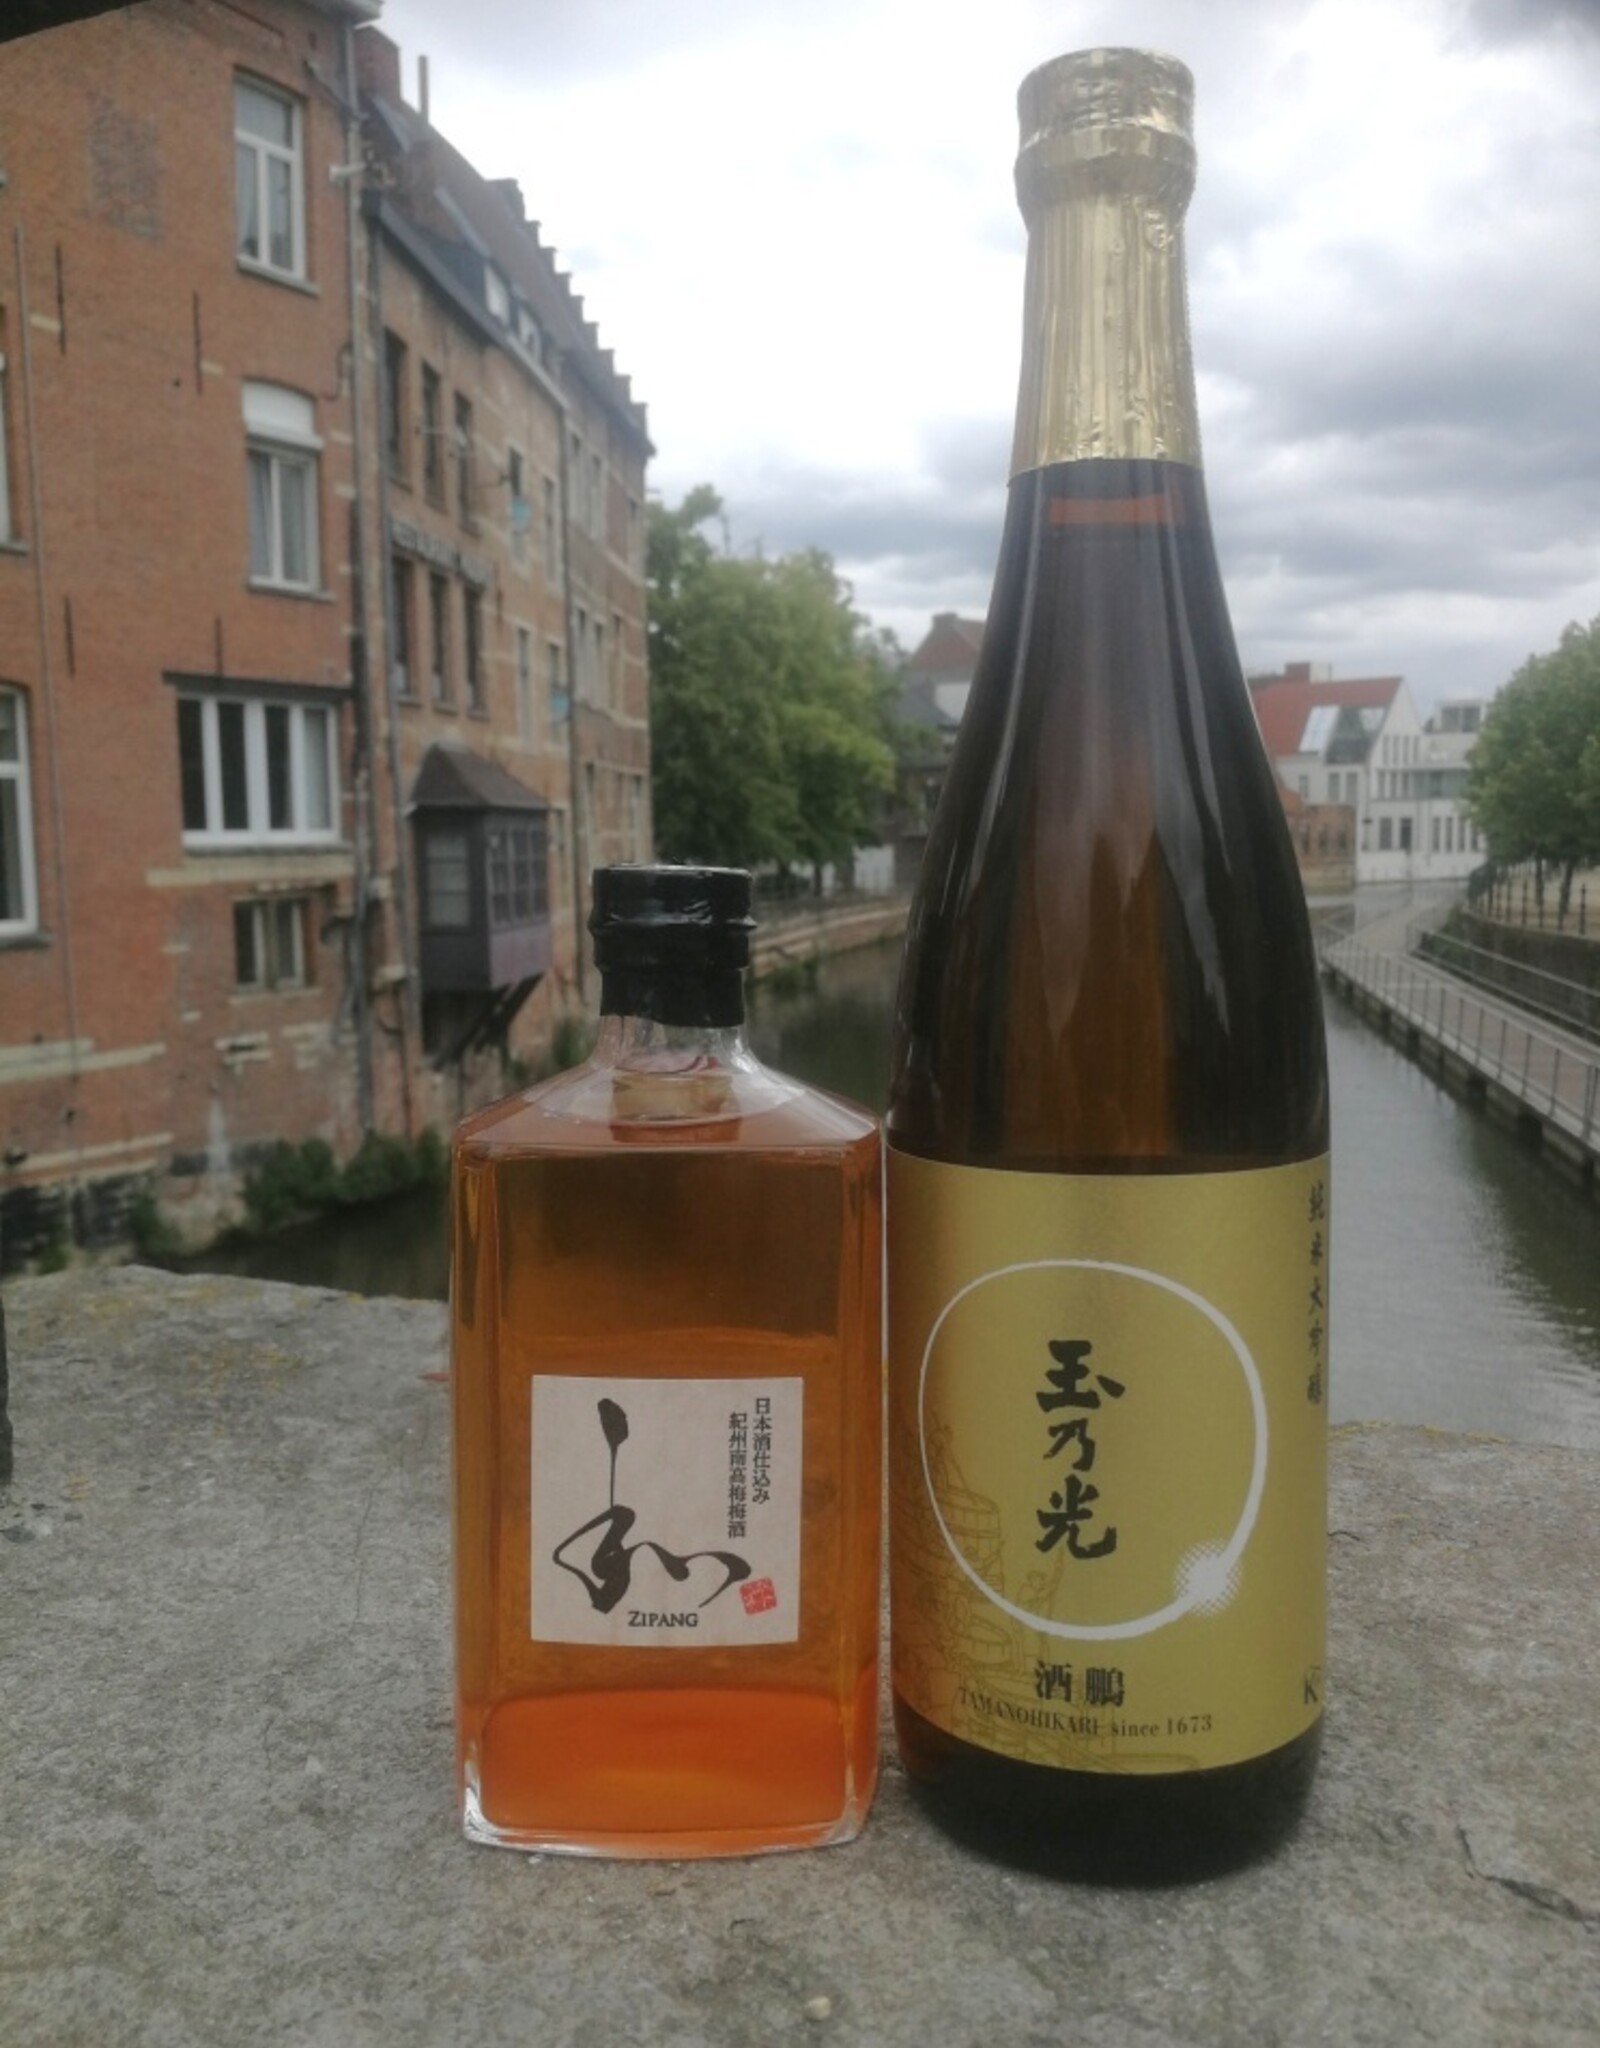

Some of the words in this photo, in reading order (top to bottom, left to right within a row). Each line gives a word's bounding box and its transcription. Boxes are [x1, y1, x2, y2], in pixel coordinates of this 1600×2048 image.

[728, 1412, 748, 1539] 紀州南高梅梅酒
[752, 1398, 772, 1504] 日本酒仕込み
[1035, 1340, 1126, 1559] 玉乃光
[957, 1686, 1100, 1736] TAMANOHIKARI
[1110, 1724, 1160, 1738] since
[1167, 1714, 1213, 1736] 1673
